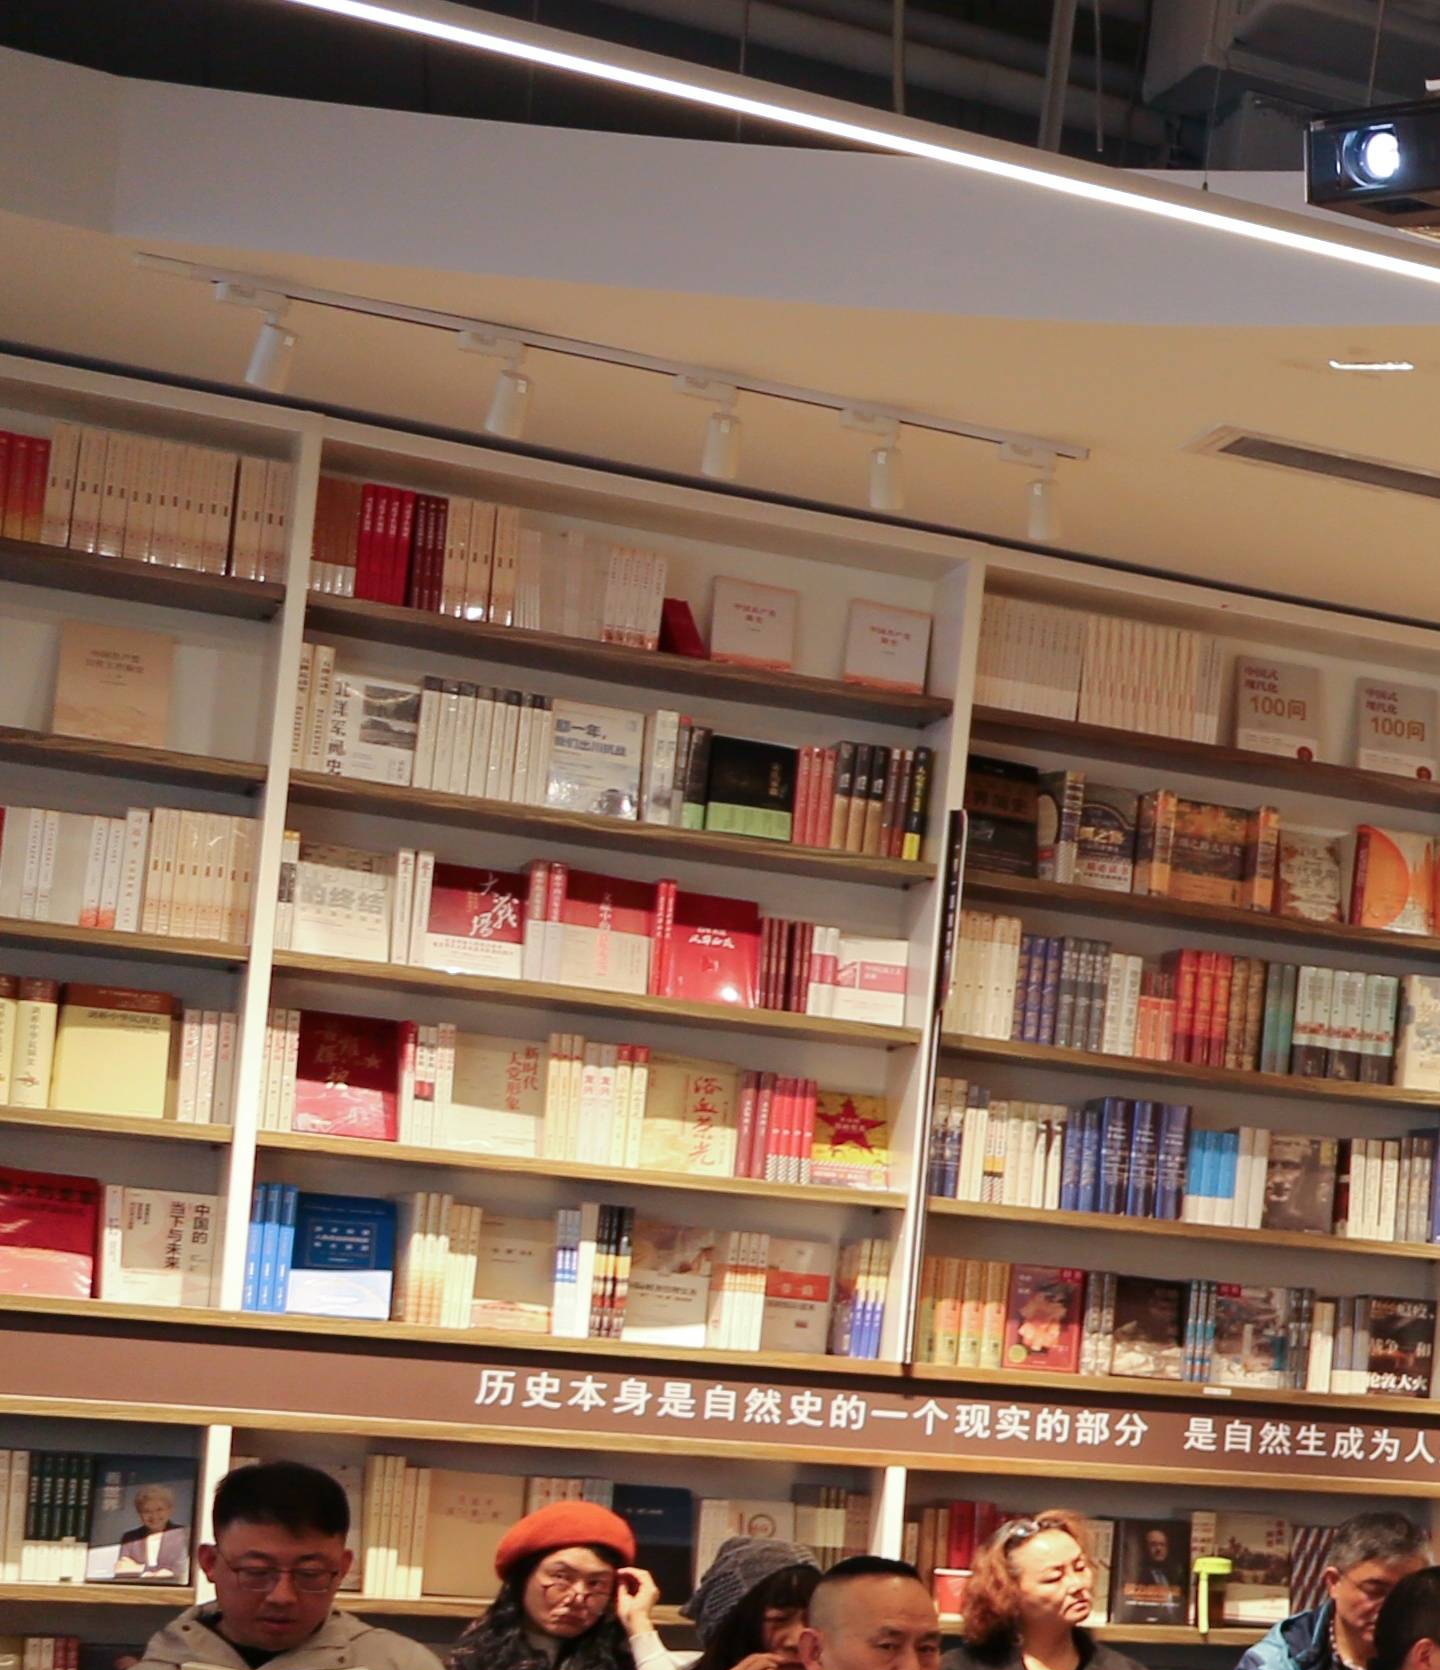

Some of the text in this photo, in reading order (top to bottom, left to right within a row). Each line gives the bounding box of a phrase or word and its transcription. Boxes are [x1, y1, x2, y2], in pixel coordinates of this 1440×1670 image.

[1250, 696, 1307, 721] 100问
[1371, 717, 1425, 742] 100问
[474, 1368, 1149, 1448] 历史本身是自然史的一个现实的部分
